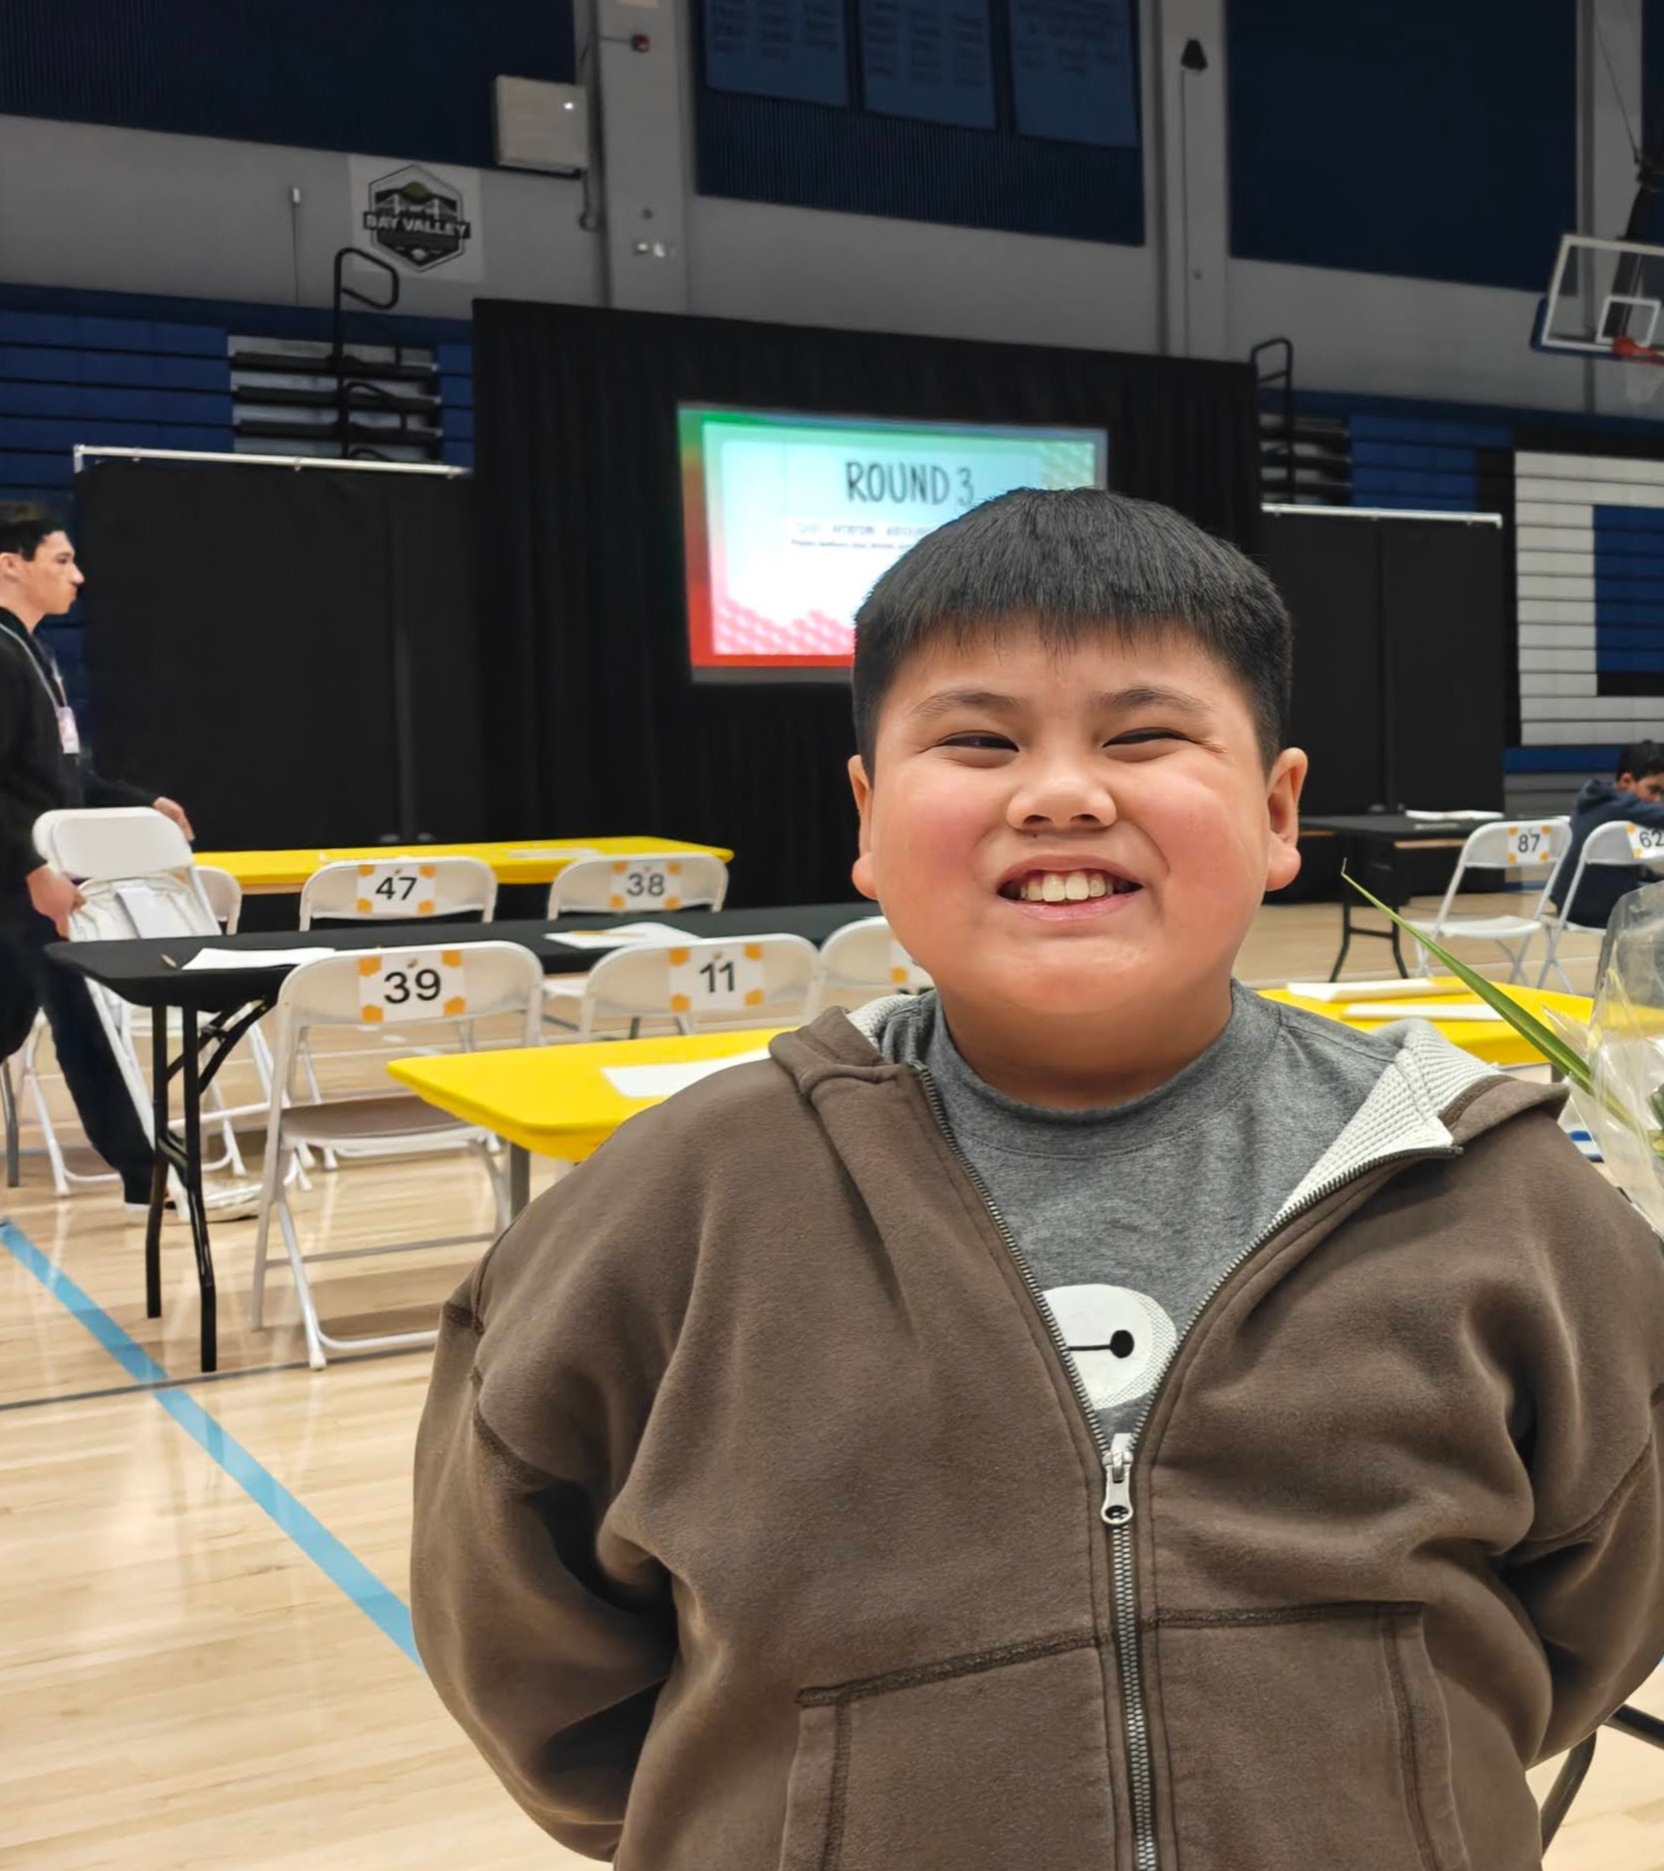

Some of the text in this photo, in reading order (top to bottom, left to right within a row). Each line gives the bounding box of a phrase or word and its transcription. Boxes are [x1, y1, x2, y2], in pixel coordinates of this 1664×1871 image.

[365, 214, 468, 238] BAY VALLEY
[845, 461, 975, 507] ROUND 3
[1518, 834, 1541, 853] 87
[375, 876, 418, 901] 47
[626, 872, 666, 897] 38
[384, 969, 441, 1004] 39
[699, 961, 736, 993] 11
